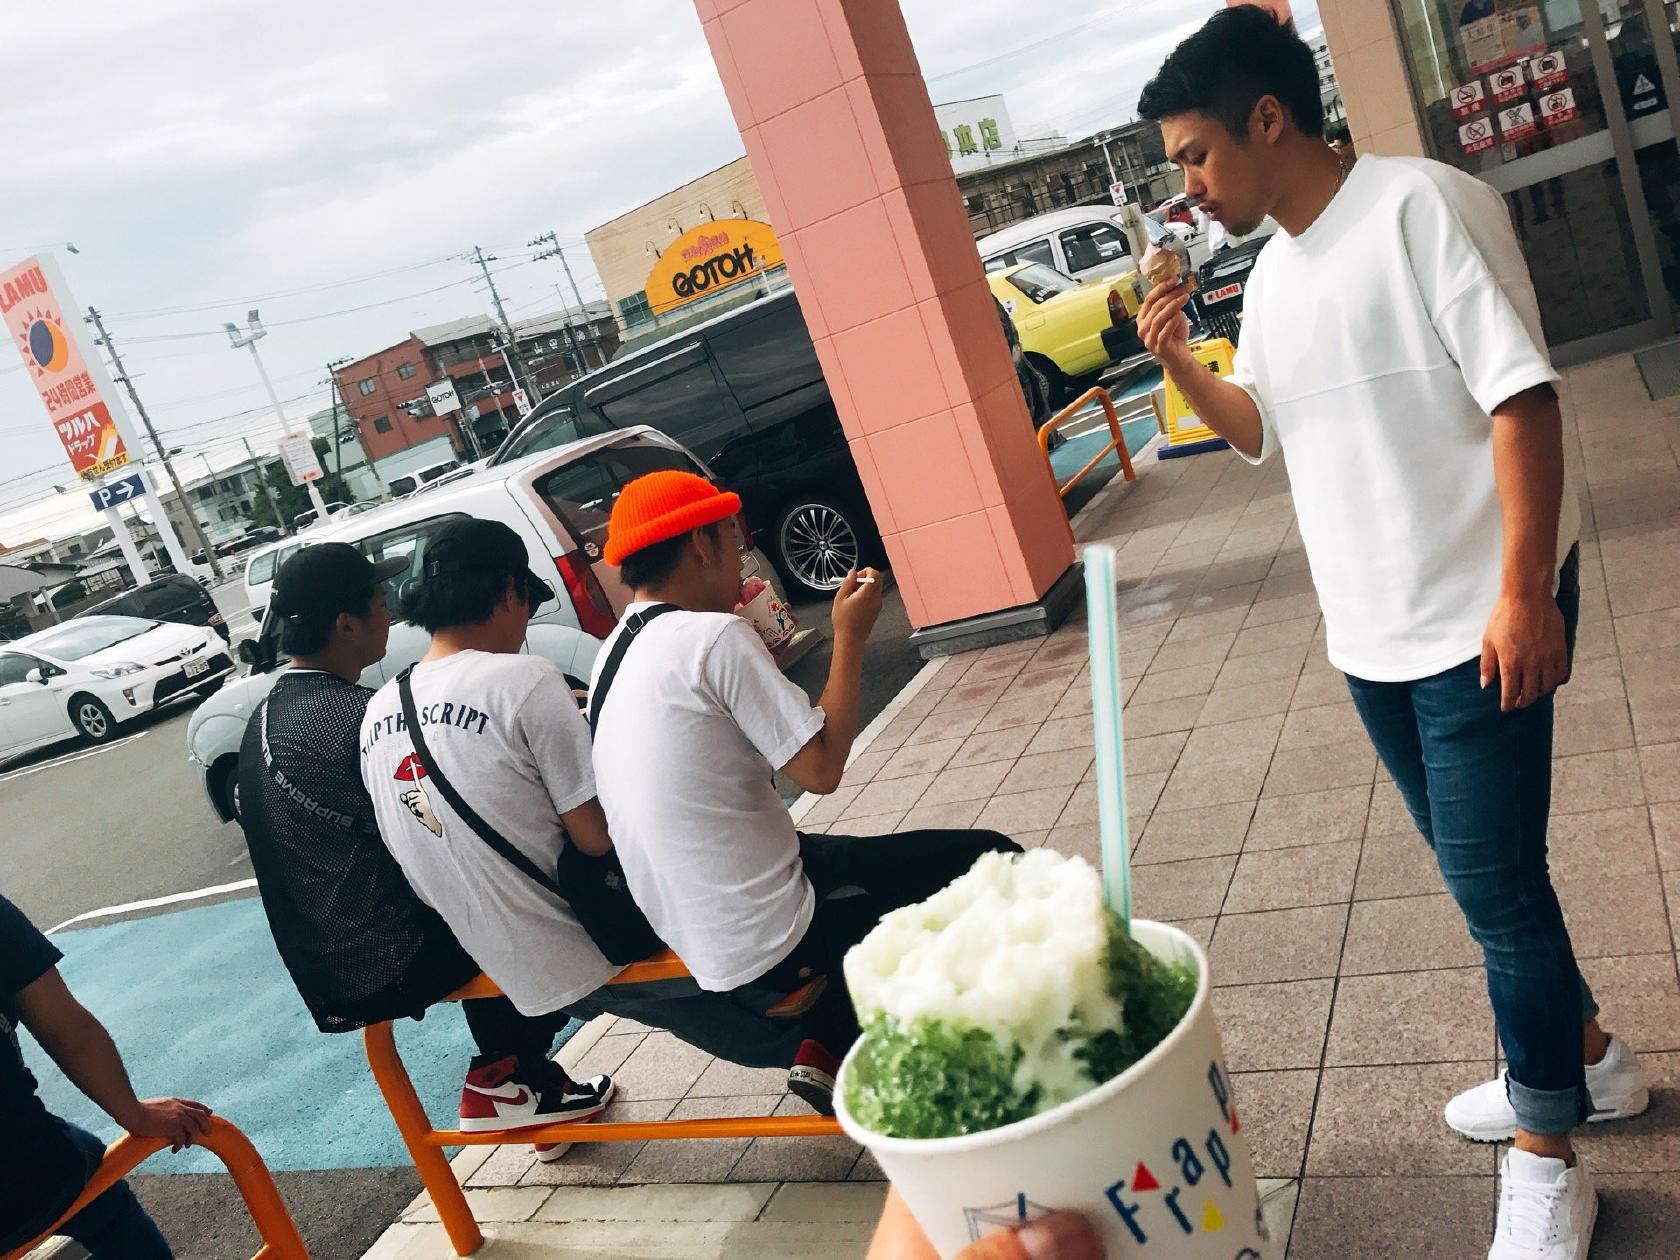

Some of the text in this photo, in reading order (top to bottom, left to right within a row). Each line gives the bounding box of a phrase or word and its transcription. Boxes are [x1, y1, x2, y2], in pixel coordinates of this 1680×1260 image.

[672, 243, 755, 298] GOTOH
[0, 266, 48, 313] LAMU
[1214, 284, 1240, 299] LAMU
[42, 372, 96, 411] 24時間営業
[60, 410, 101, 439] ツルハ
[99, 488, 111, 507] P
[421, 702, 490, 735] SCRIPT
[275, 770, 354, 827] SUPREME
